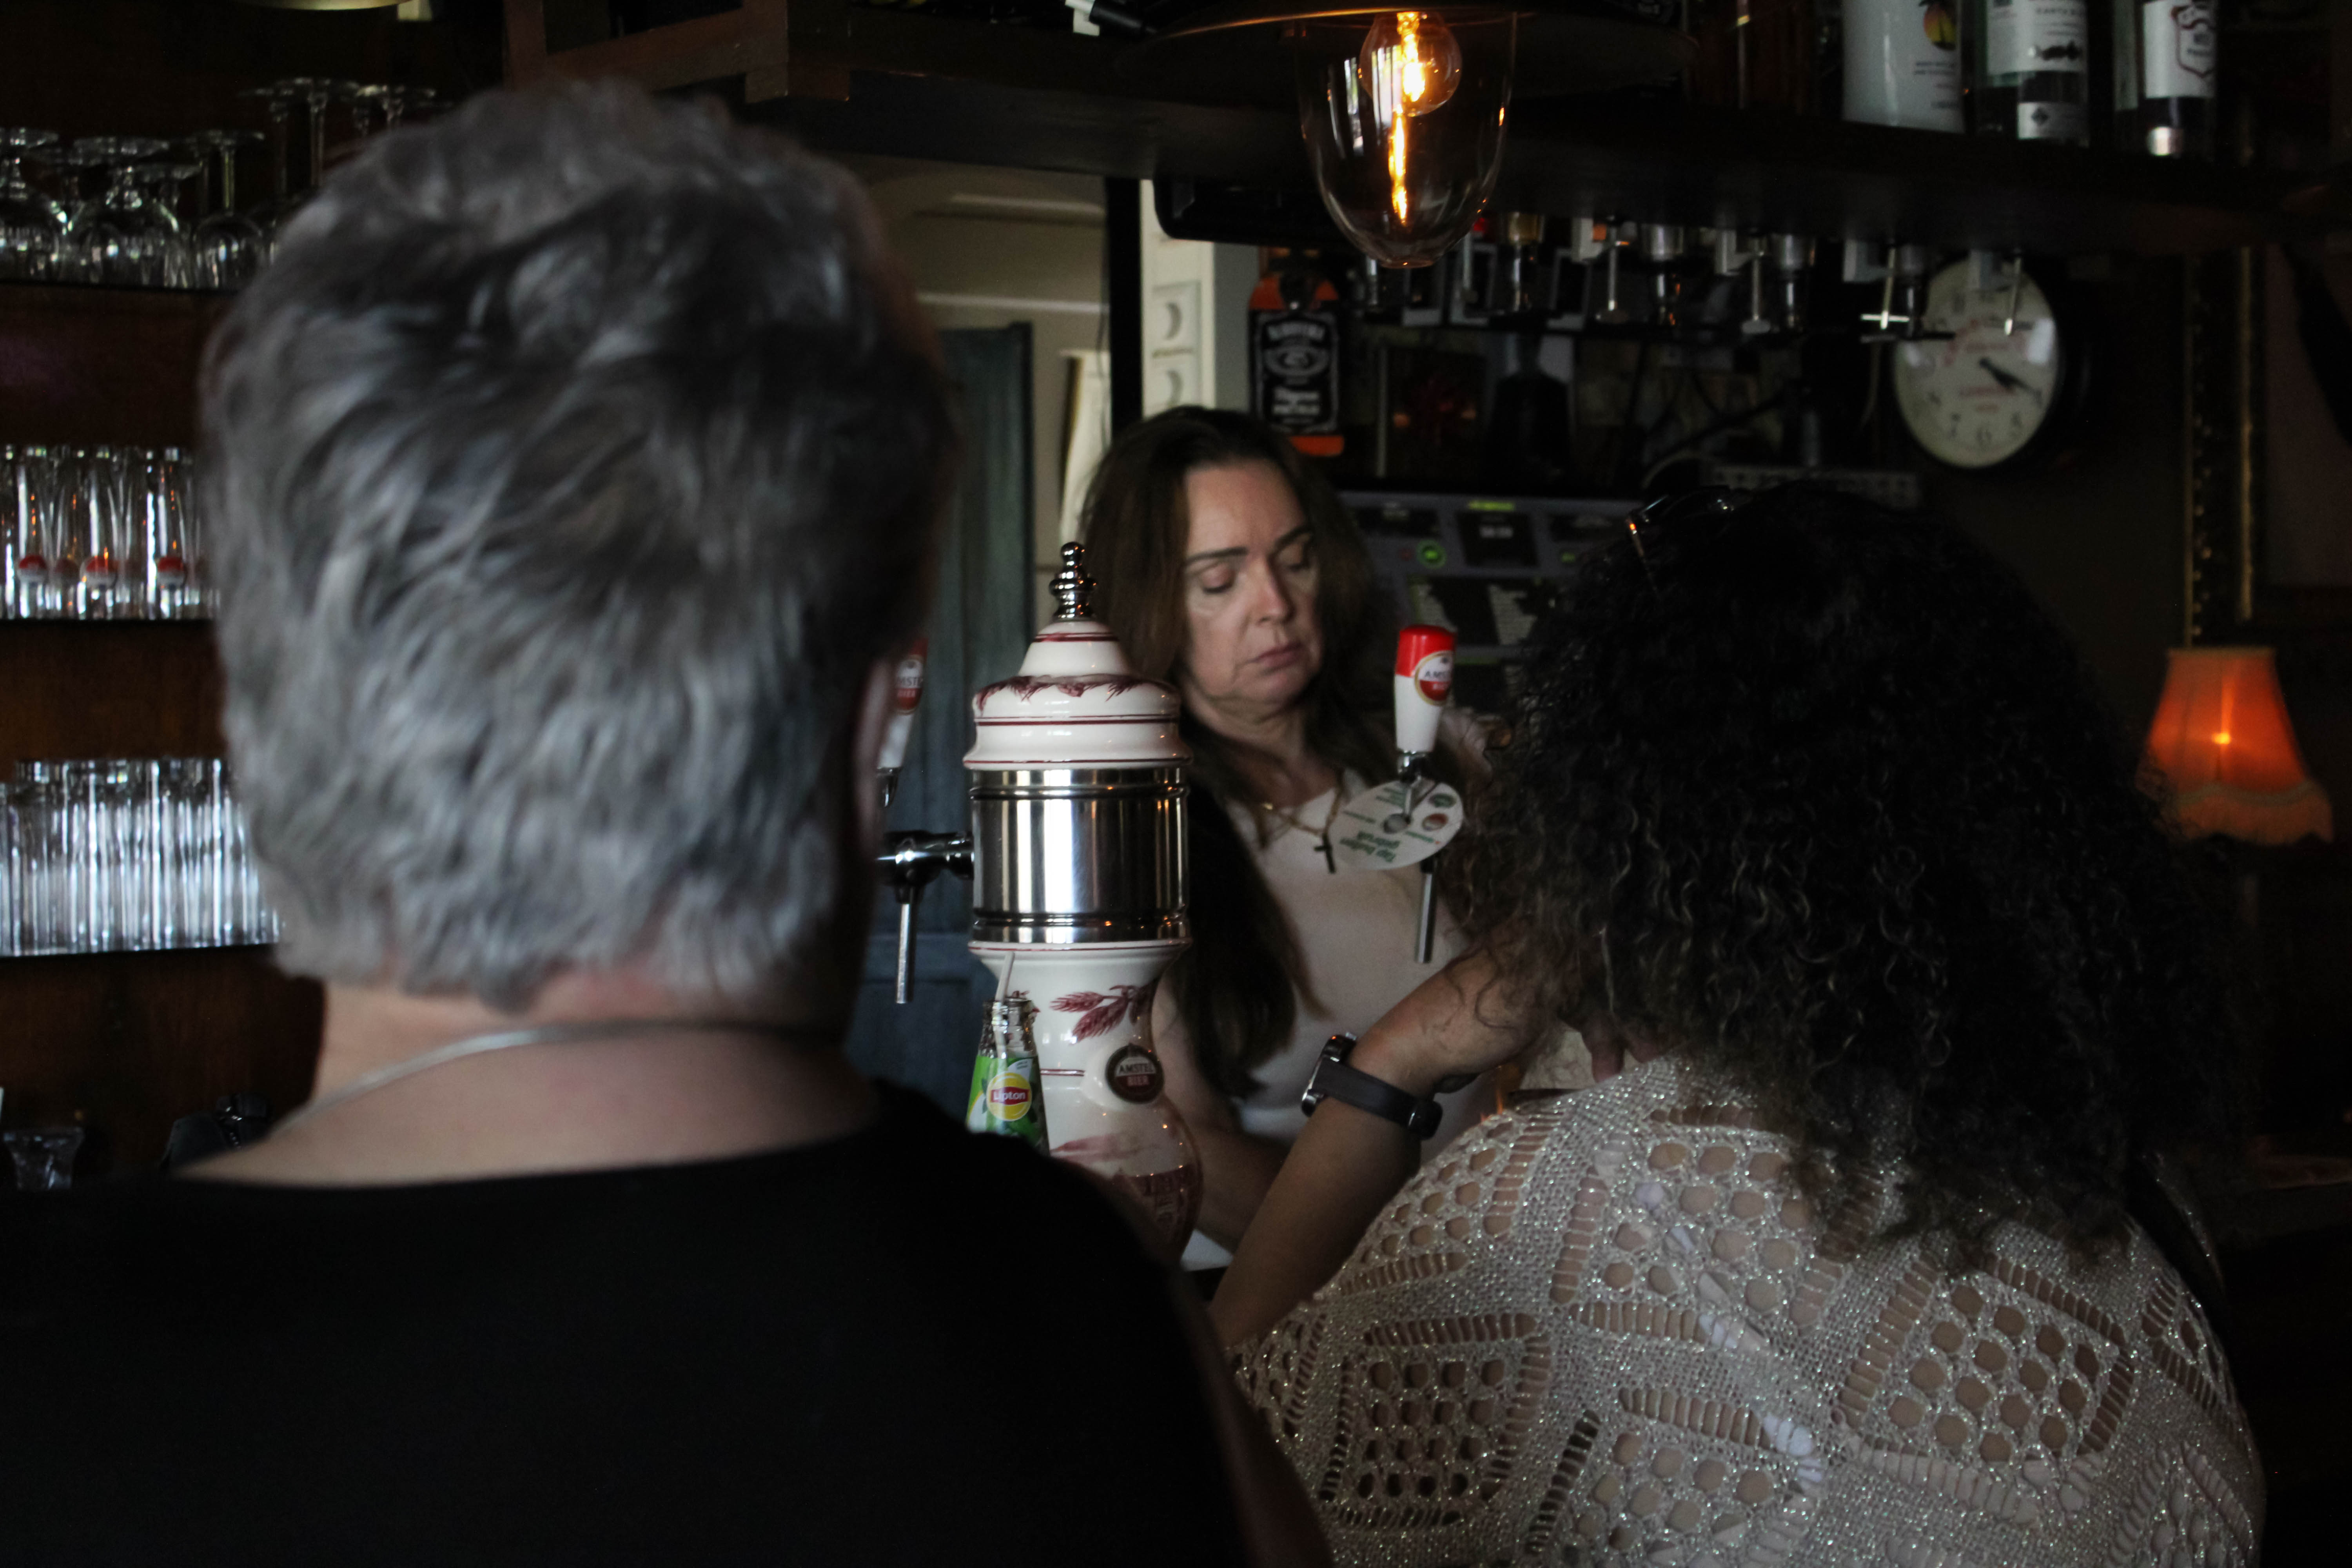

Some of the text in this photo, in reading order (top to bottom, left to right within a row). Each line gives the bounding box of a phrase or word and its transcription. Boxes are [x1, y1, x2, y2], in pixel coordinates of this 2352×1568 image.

[1118, 1063, 1154, 1073] AMSTEL
[1127, 1075, 1150, 1087] BIER
[993, 1091, 1026, 1101] Lipton
